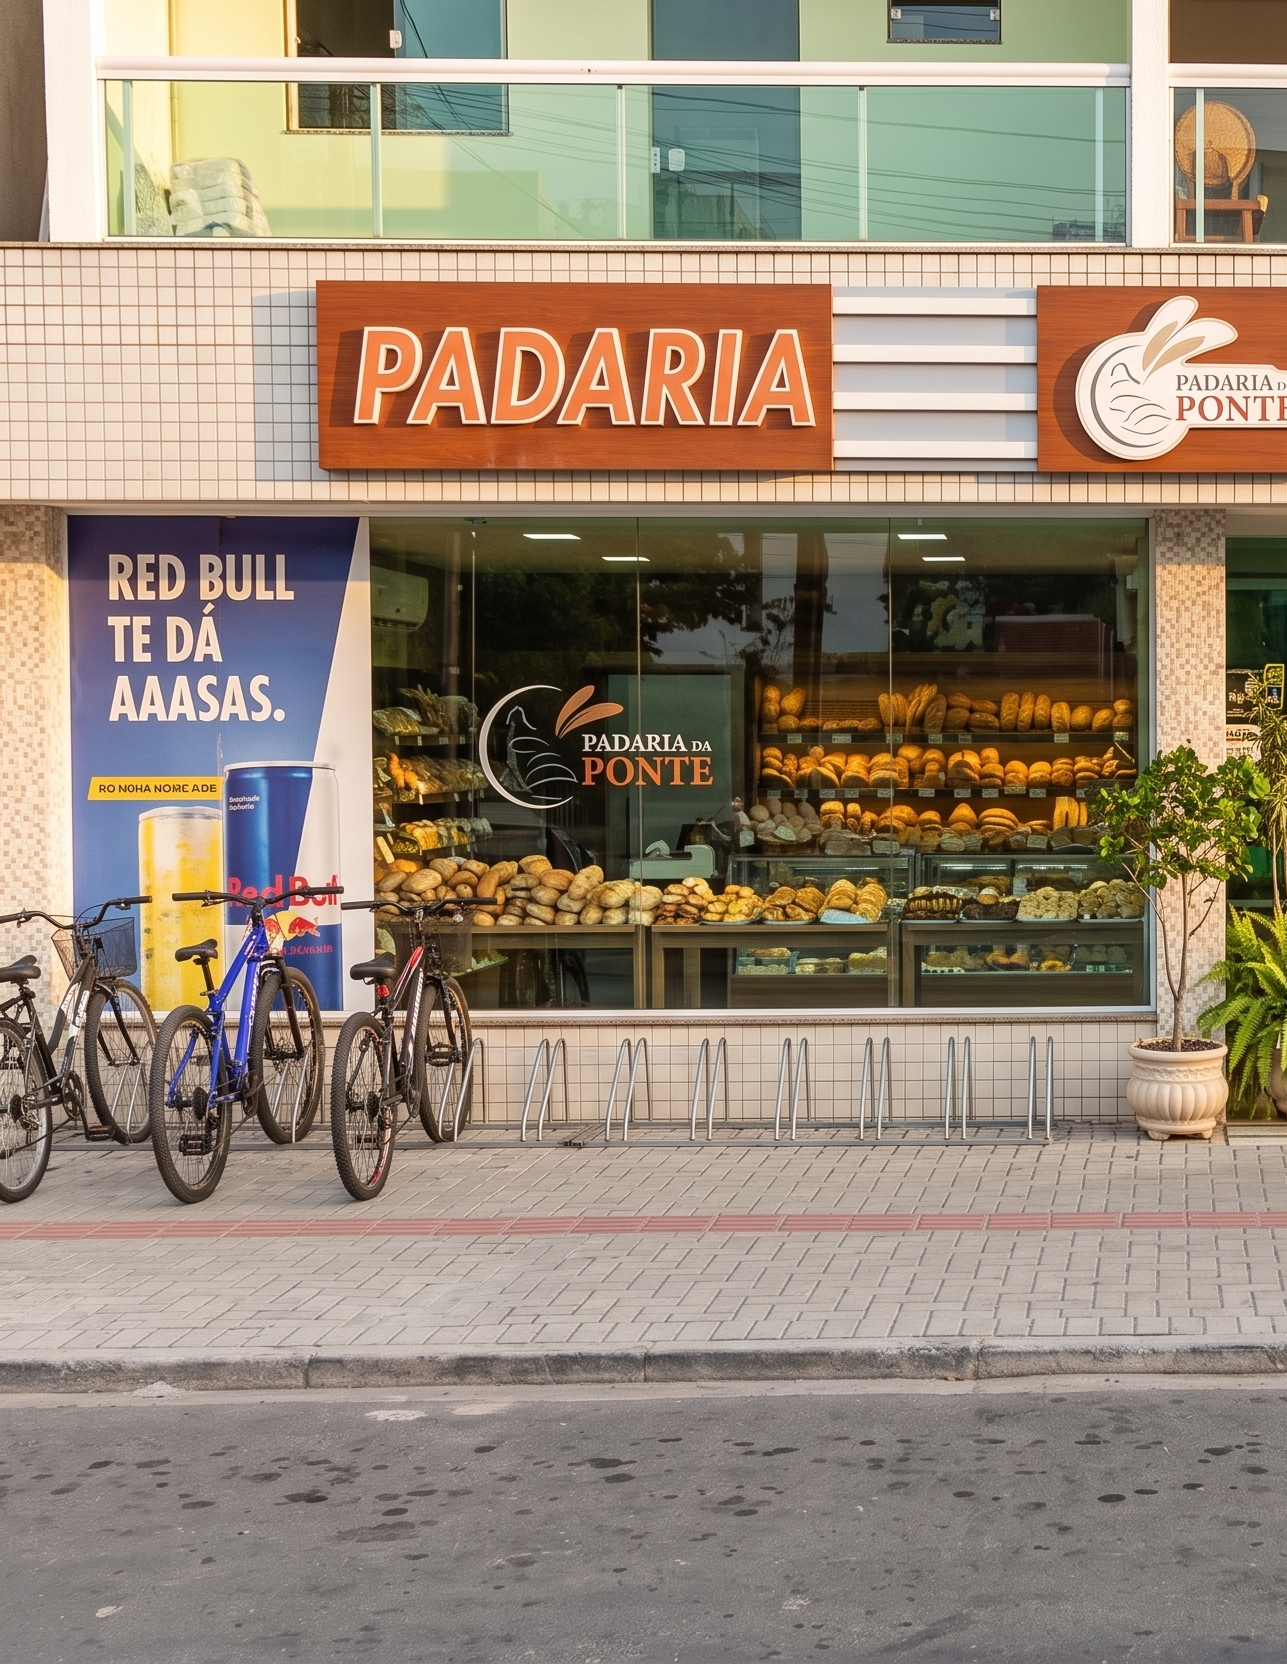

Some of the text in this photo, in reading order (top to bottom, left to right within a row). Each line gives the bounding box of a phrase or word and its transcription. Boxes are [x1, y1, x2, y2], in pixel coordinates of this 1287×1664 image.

[353, 326, 817, 427] PADARIA
[1175, 374, 1274, 391] PADARIA
[108, 554, 295, 601] RED BULL
[107, 601, 223, 663] TE DÁ
[108, 674, 286, 722] AAASAS.
[581, 733, 713, 752] PADARIA DA
[581, 756, 714, 786] PONTE
